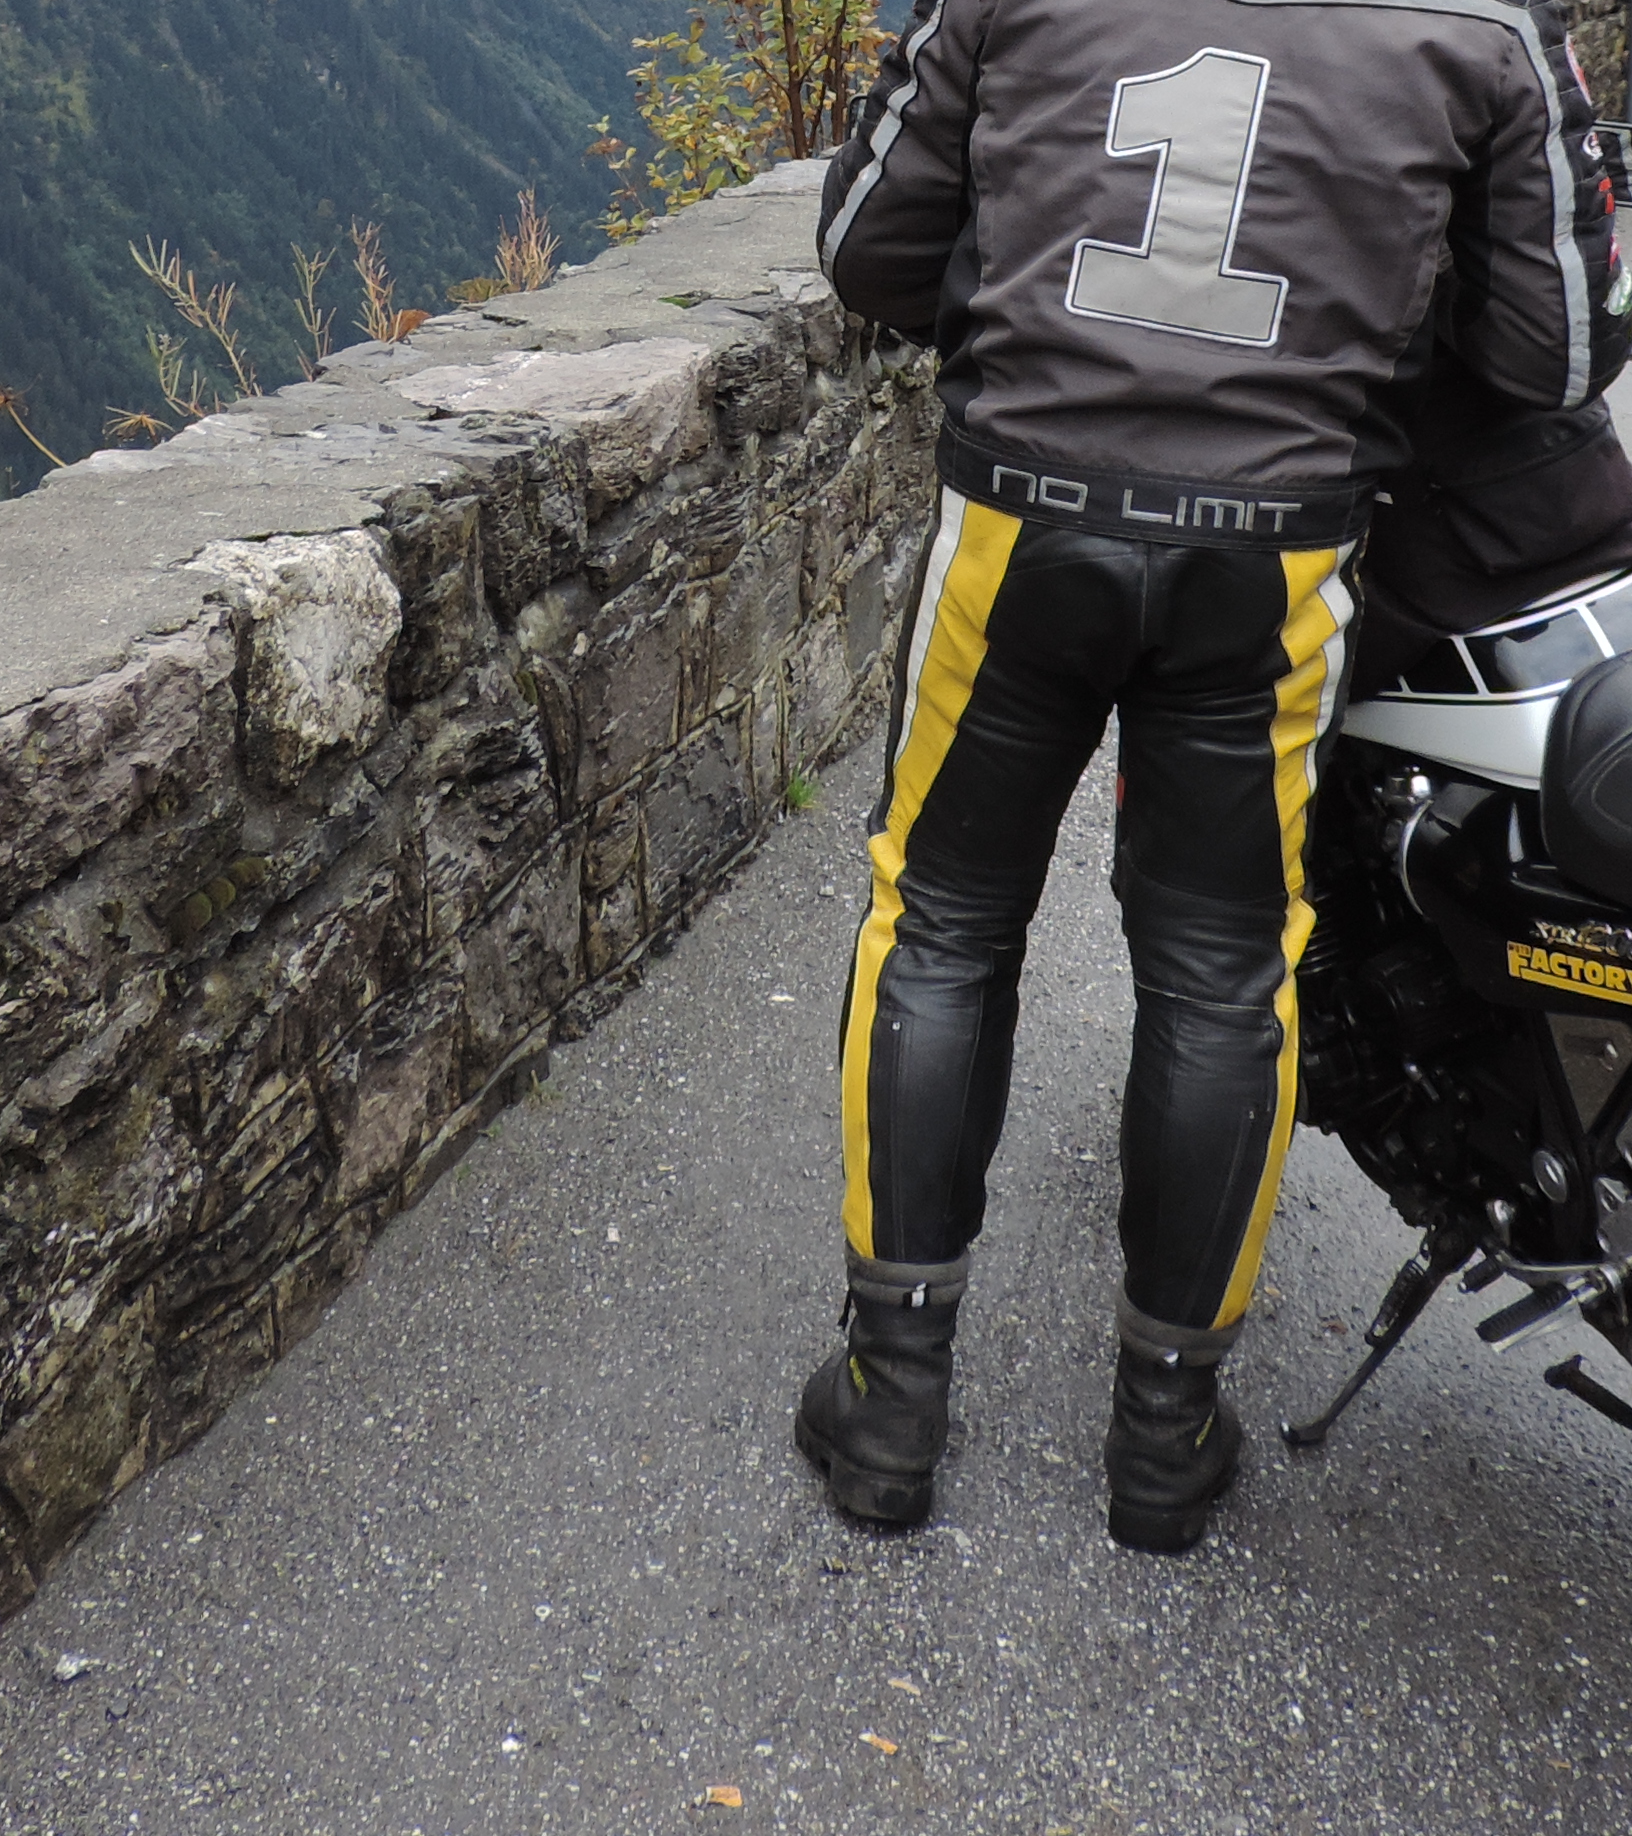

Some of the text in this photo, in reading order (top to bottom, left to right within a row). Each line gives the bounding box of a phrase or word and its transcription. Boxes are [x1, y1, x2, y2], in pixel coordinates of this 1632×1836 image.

[1065, 47, 1290, 349] 1
[992, 464, 1304, 533] NO LIMIT
